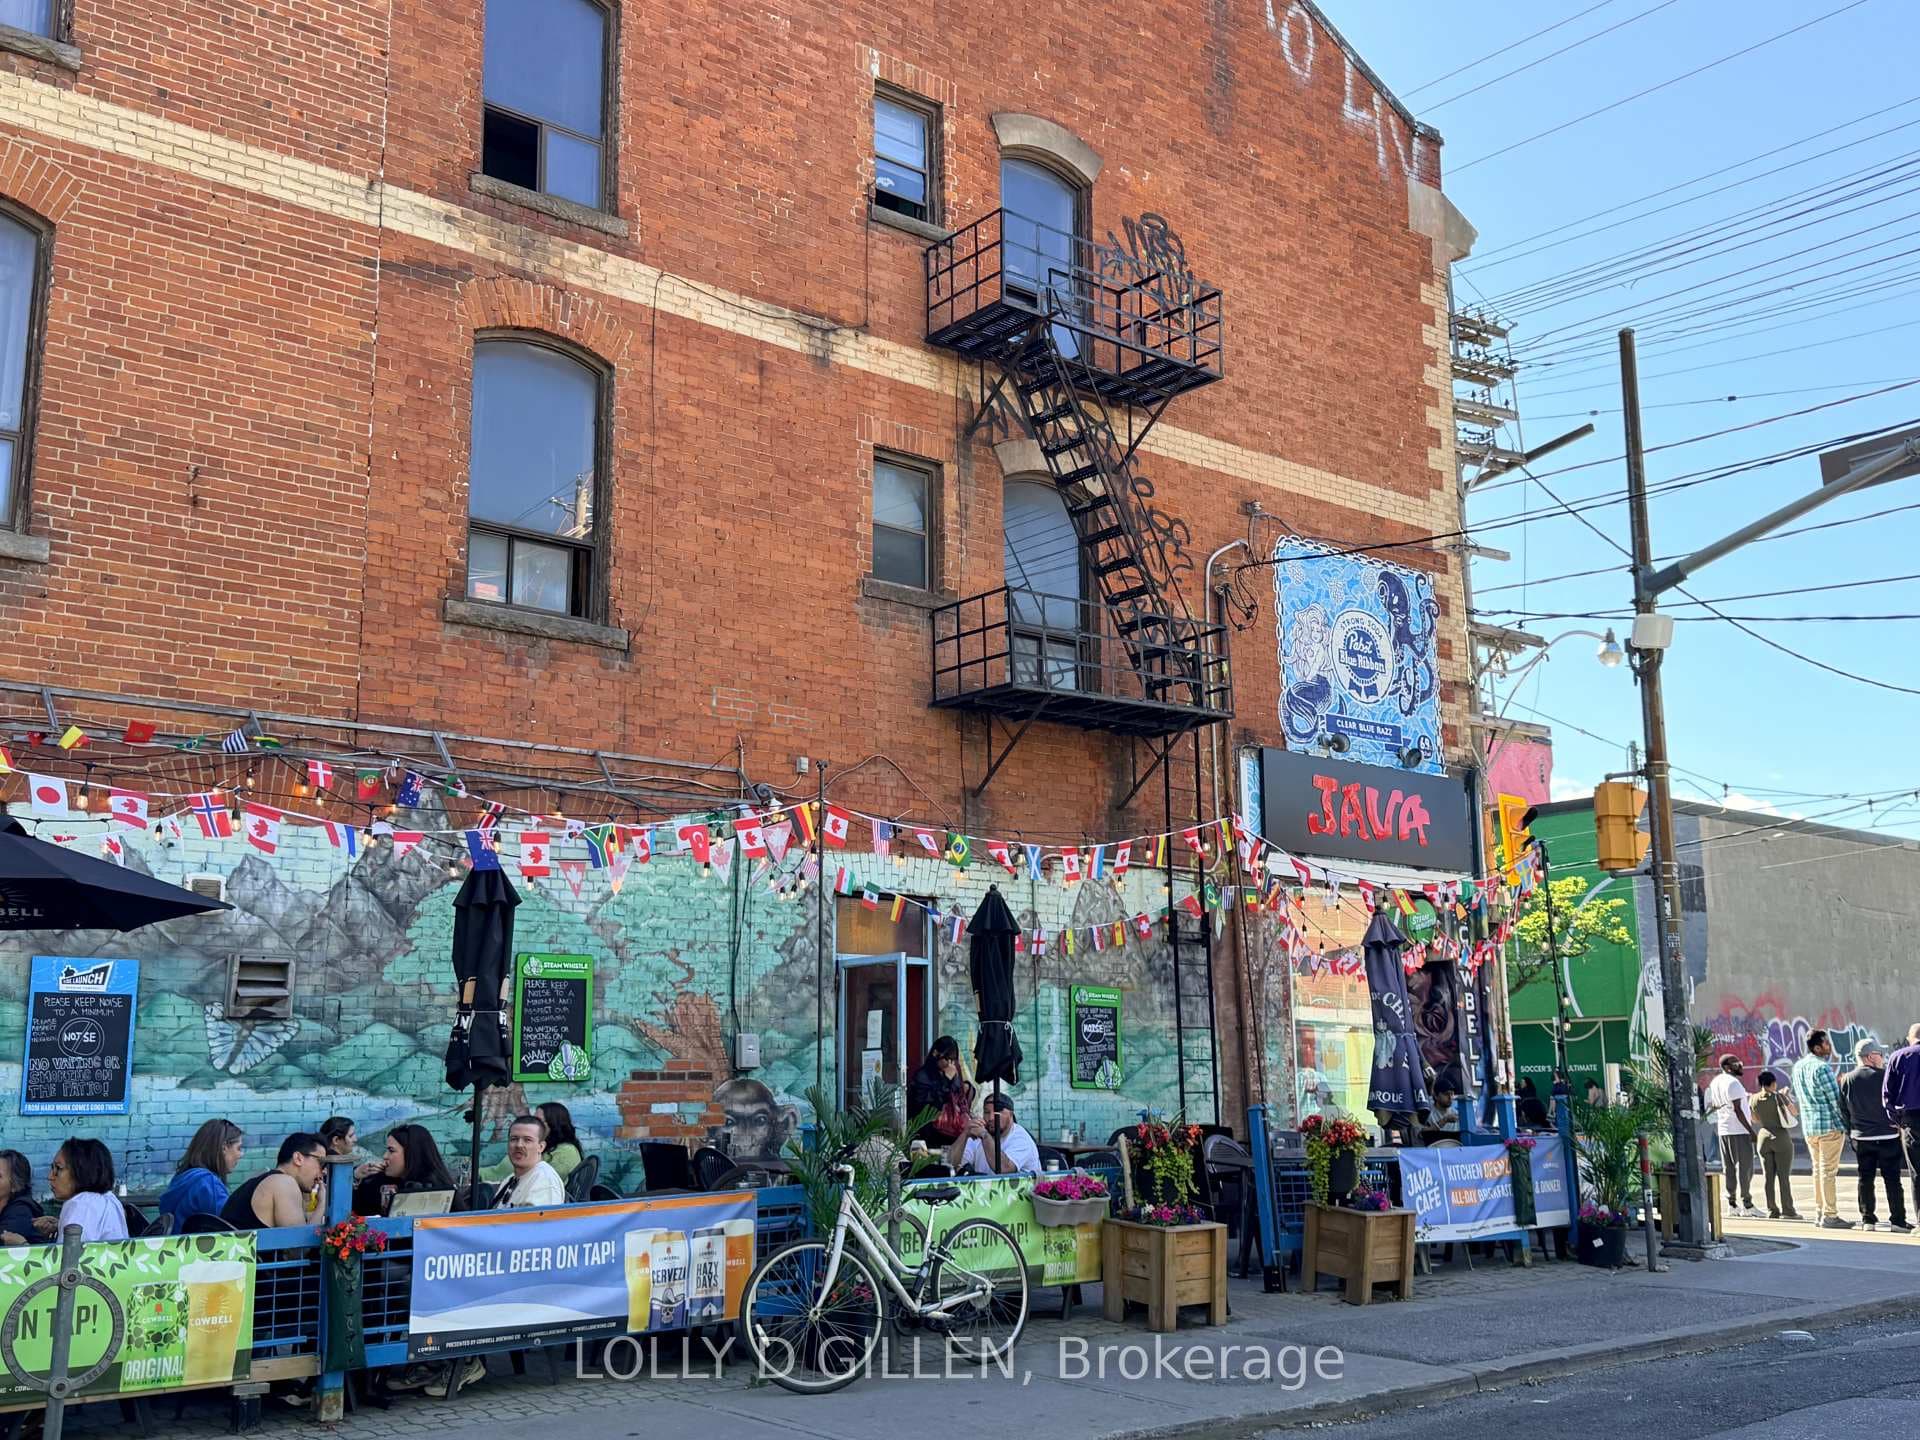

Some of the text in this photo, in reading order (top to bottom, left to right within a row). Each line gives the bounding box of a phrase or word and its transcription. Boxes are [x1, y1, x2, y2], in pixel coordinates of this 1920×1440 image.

[1341, 617, 1383, 640] STRONG SODA
[1349, 631, 1373, 654] Pabst
[1340, 649, 1385, 673] Blue Ribbon
[1336, 719, 1357, 730] CLEAR
[1359, 723, 1375, 734] BLUE
[1376, 726, 1393, 737] RAZZ
[1308, 774, 1431, 848] JAVA
[563, 962, 589, 970] WHISTLE
[72, 971, 105, 985] LAUNCH
[525, 979, 569, 989] PLEASE KEEP
[556, 989, 565, 997] TO
[44, 997, 124, 1008] PLEASE KEEP NOISE
[1458, 925, 1483, 1087] CWBELL
[54, 1009, 66, 1017] TO
[1083, 1023, 1104, 1033] NOISE
[29, 1055, 121, 1071] NO VAPING OR
[1520, 1065, 1552, 1073] SOCCER'S
[29, 1069, 113, 1085] SMOKING ON
[28, 1083, 57, 1099] THE
[1447, 1162, 1483, 1182] KITCHEN
[1451, 1189, 1477, 1204] ALL-DAY
[1540, 1179, 1561, 1193] DINNER
[424, 1240, 616, 1281] COWBELL BEER ON TAP!
[696, 1261, 719, 1276] HAZY
[696, 1275, 718, 1289] DAYS
[46, 1303, 98, 1338] TP!
[141, 1315, 173, 1325] COWBELL
[189, 1314, 233, 1328] COWBELL
[417, 1345, 440, 1353] COWBELL
[124, 1354, 185, 1380] ORIGINAL
